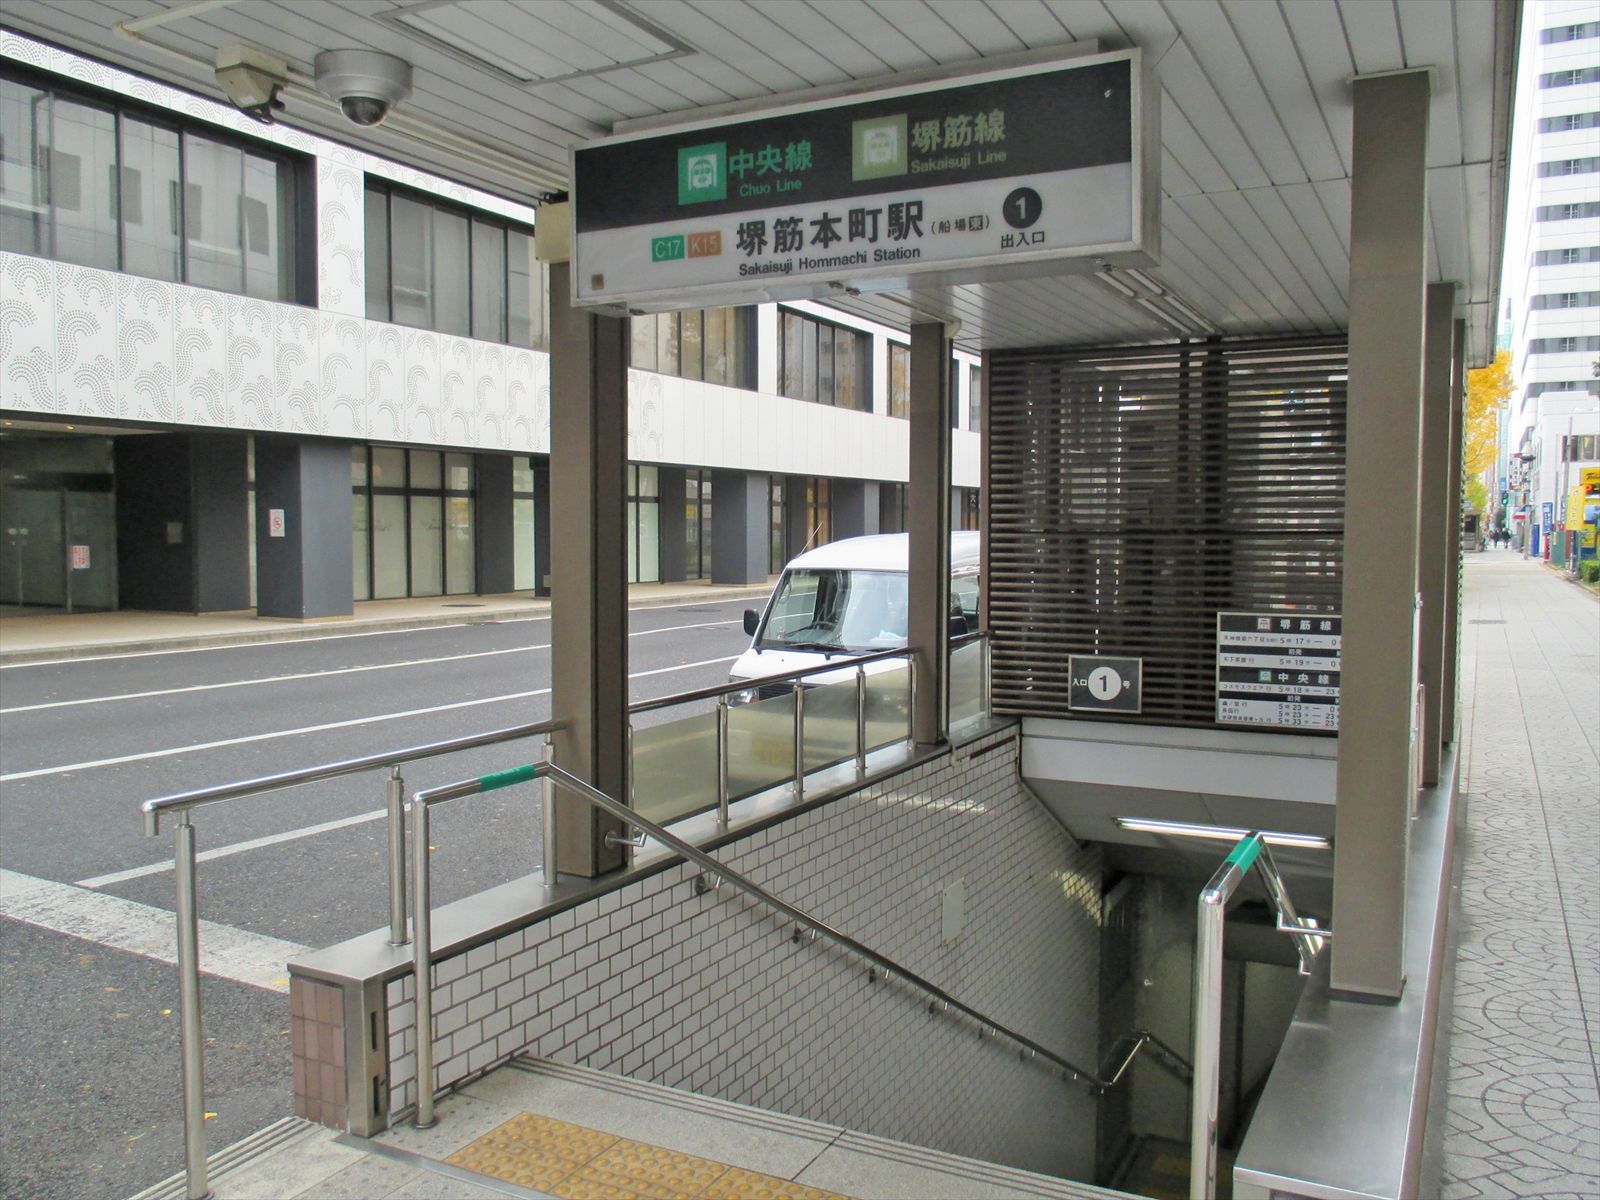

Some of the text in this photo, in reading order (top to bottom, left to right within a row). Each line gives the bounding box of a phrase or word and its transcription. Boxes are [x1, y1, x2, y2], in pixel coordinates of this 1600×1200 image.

[911, 108, 1006, 153] 堺筋線
[729, 139, 813, 180] 中央線
[911, 151, 1007, 174] Sakaisuji Line
[739, 179, 802, 197] Chuo Line
[736, 200, 924, 257] 堺筋本町駅
[1001, 231, 1045, 249] 出入口
[655, 234, 719, 258] C17 K15
[739, 247, 921, 277] Sakaisuji Hommachi Station
[1072, 678, 1088, 687] 入口
[1098, 674, 1107, 692] 1
[1278, 672, 1329, 685] 中央線
